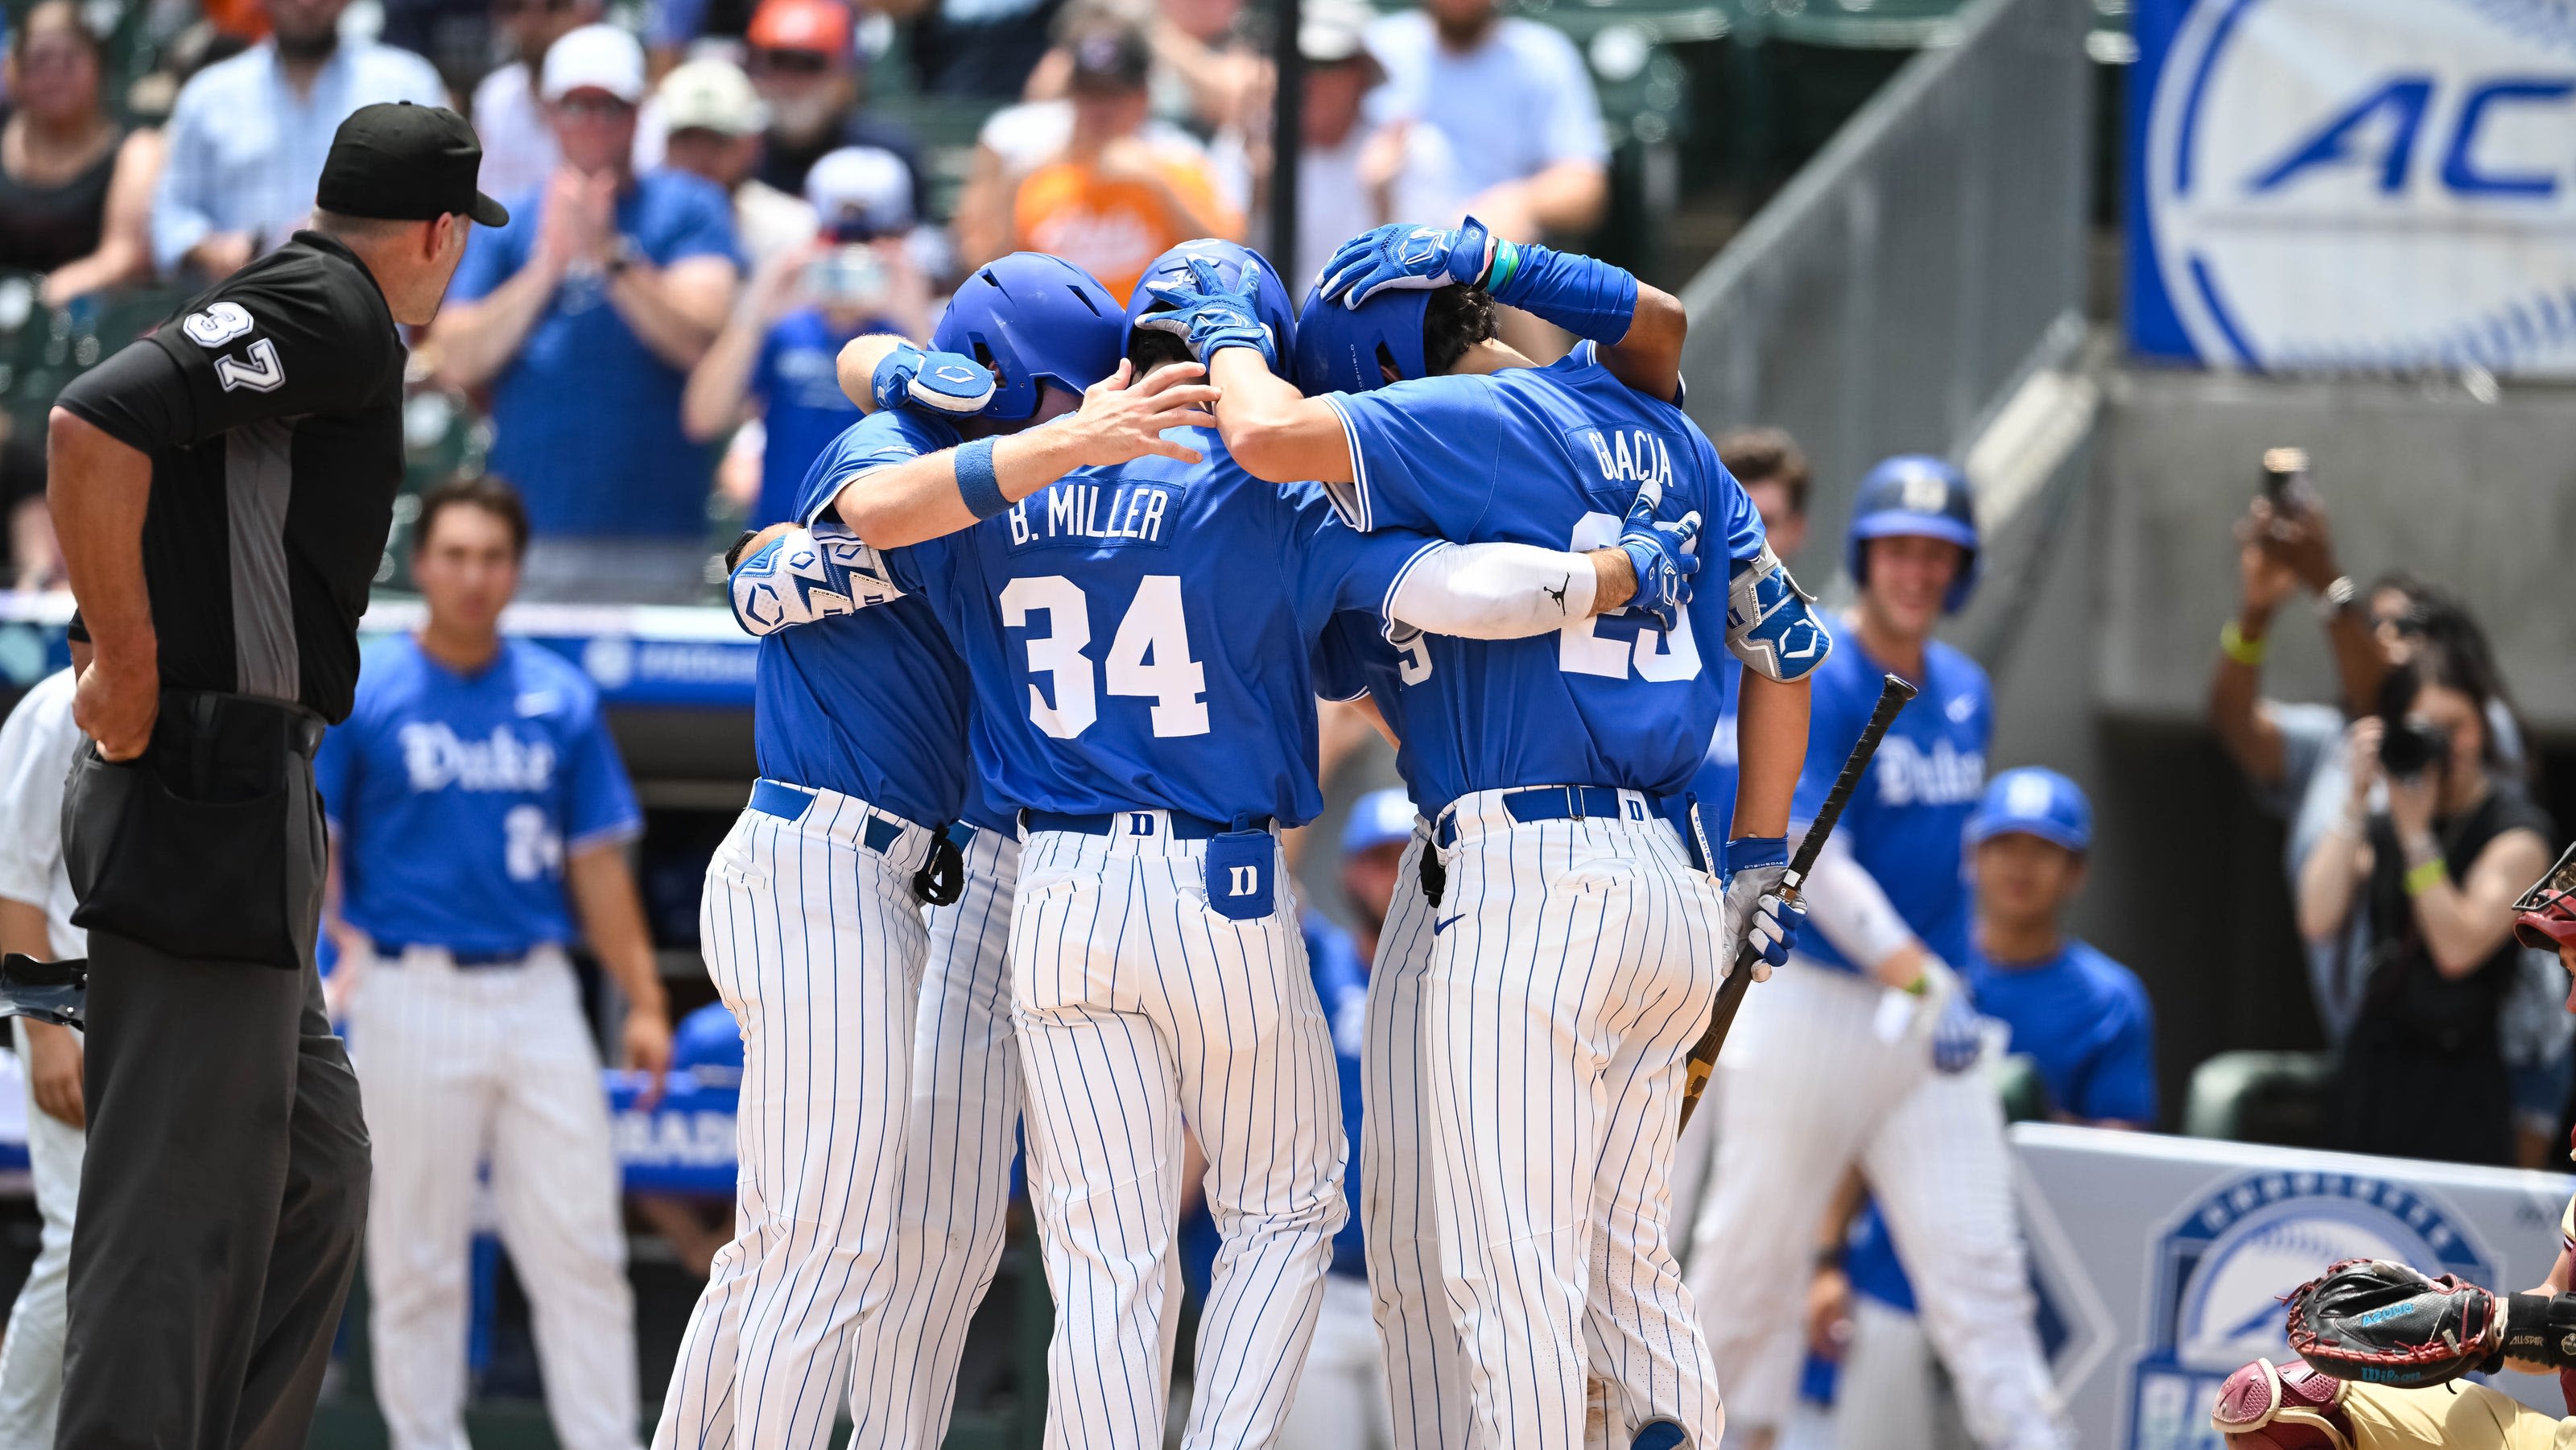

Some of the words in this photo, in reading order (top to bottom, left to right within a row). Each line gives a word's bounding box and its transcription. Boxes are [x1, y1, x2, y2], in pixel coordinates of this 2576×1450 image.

[182, 301, 287, 393] 37
[1009, 497, 1039, 546] B.
[1048, 484, 1169, 542] MILLER
[998, 574, 1211, 740] 34
[1694, 816, 1714, 871] EVOSHIELD
[1228, 865, 1257, 897] D
[2361, 1302, 2414, 1328] A2000
[2361, 1366, 2421, 1383] Wilson
